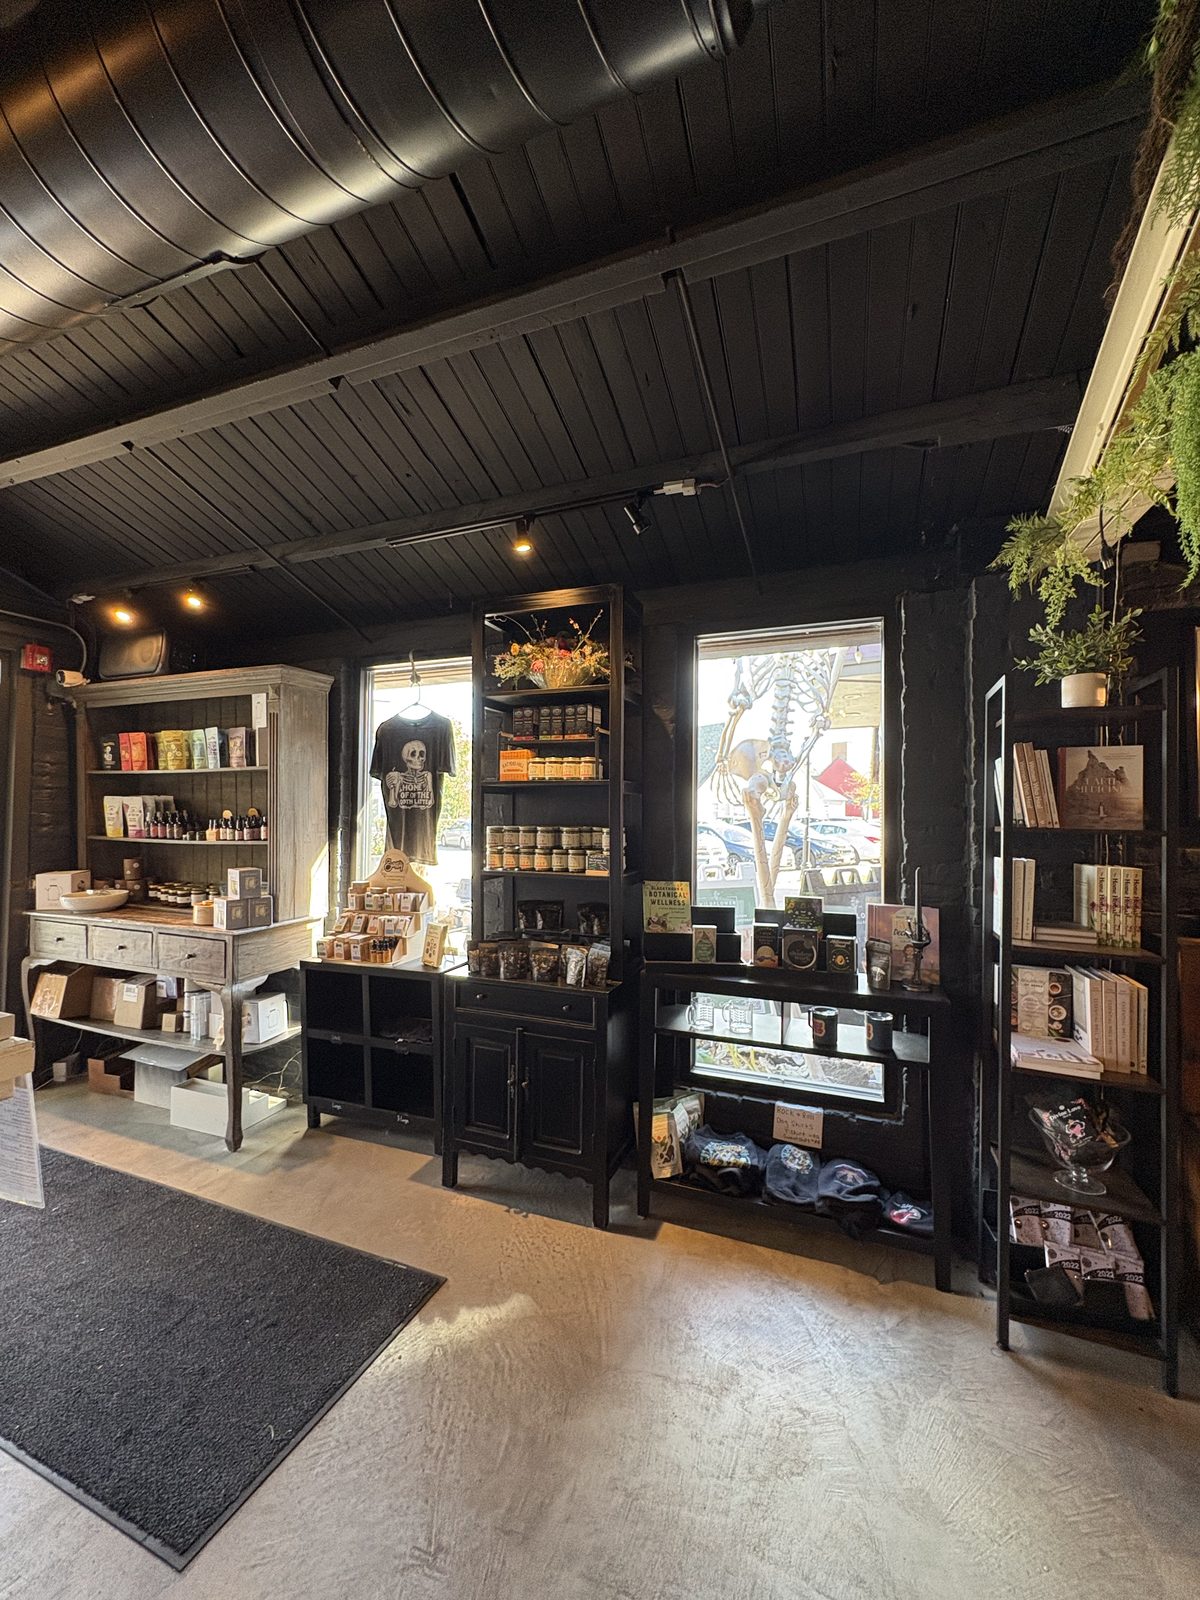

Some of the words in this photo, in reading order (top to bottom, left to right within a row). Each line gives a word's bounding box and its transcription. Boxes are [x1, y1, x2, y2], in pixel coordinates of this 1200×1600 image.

[1054, 1212, 1071, 1220] 2022
[1061, 1261, 1080, 1269] 2022
[1125, 1274, 1143, 1282] 2022
